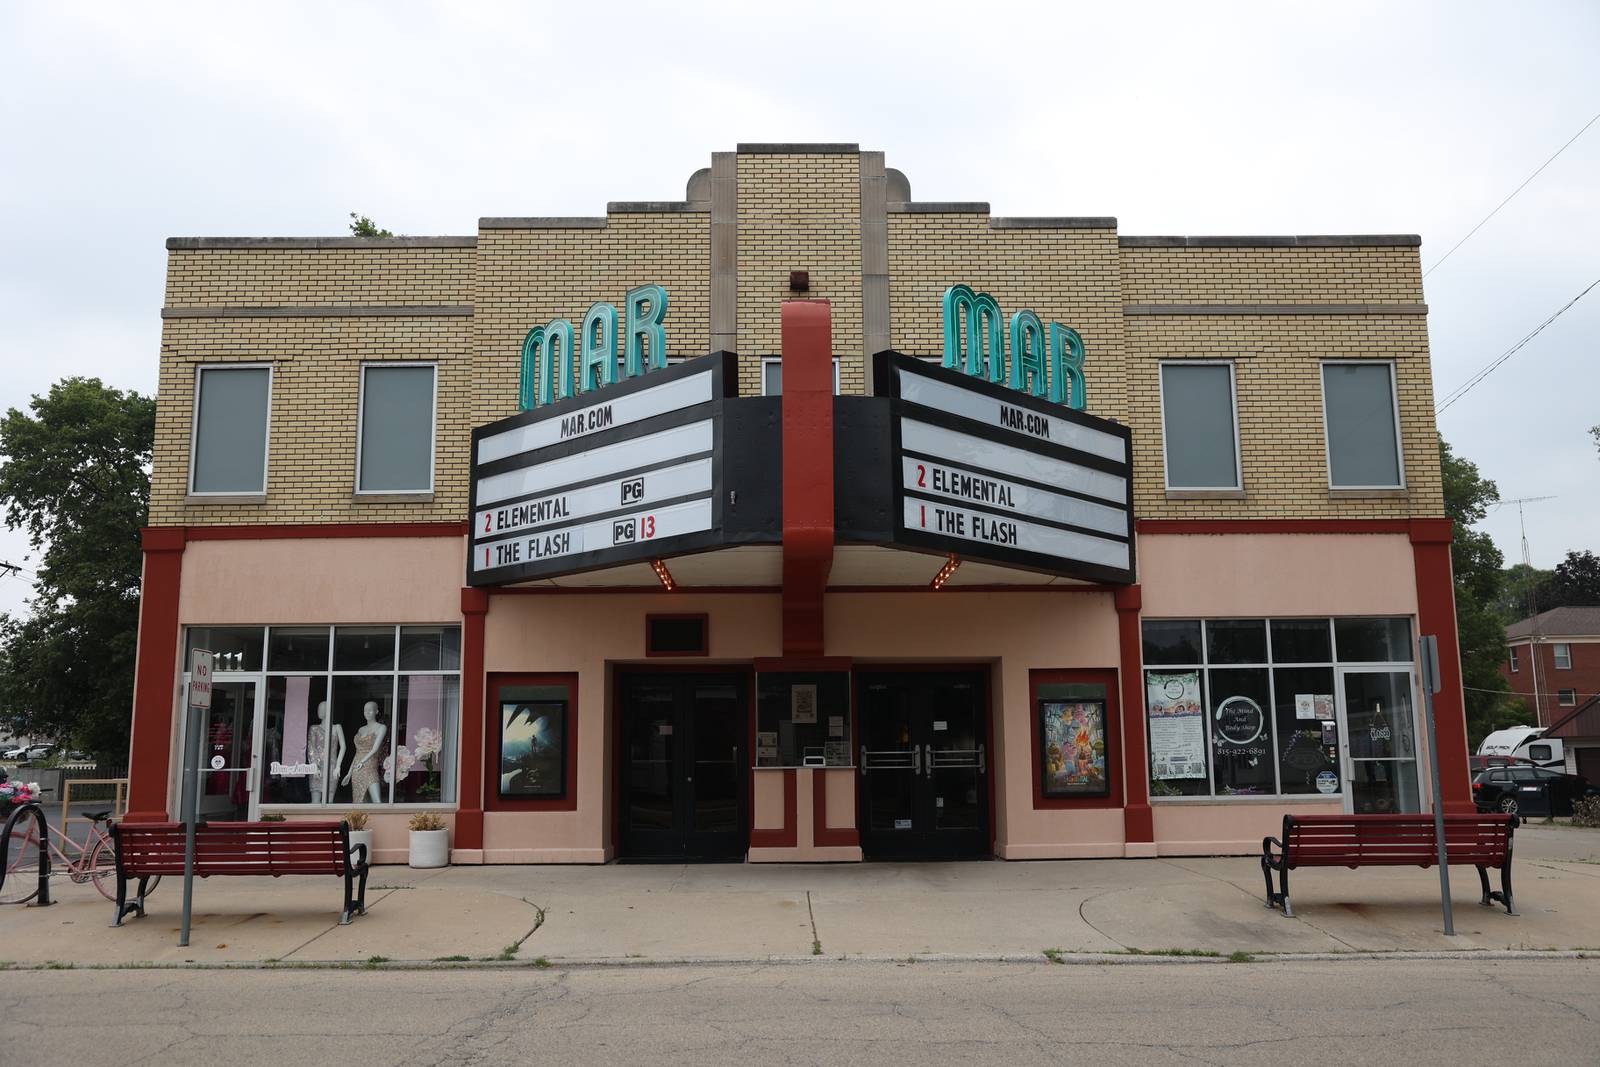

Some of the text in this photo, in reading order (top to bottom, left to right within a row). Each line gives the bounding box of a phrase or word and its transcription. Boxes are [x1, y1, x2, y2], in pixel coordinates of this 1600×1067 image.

[519, 284, 669, 411] MAR
[943, 284, 1087, 411] MAR
[560, 405, 613, 439] MAR.COM
[1000, 405, 1050, 438] MAR.COM
[485, 480, 643, 532] 2 ELEMENTAL PG
[917, 464, 1016, 508] 2 ELEMENTAL
[485, 515, 656, 567] 1 THE FLASH PG 13
[920, 505, 1017, 545] 1 THE FLASH
[197, 664, 207, 676] NO
[212, 652, 244, 671] 111
[193, 681, 210, 693] PARKING
